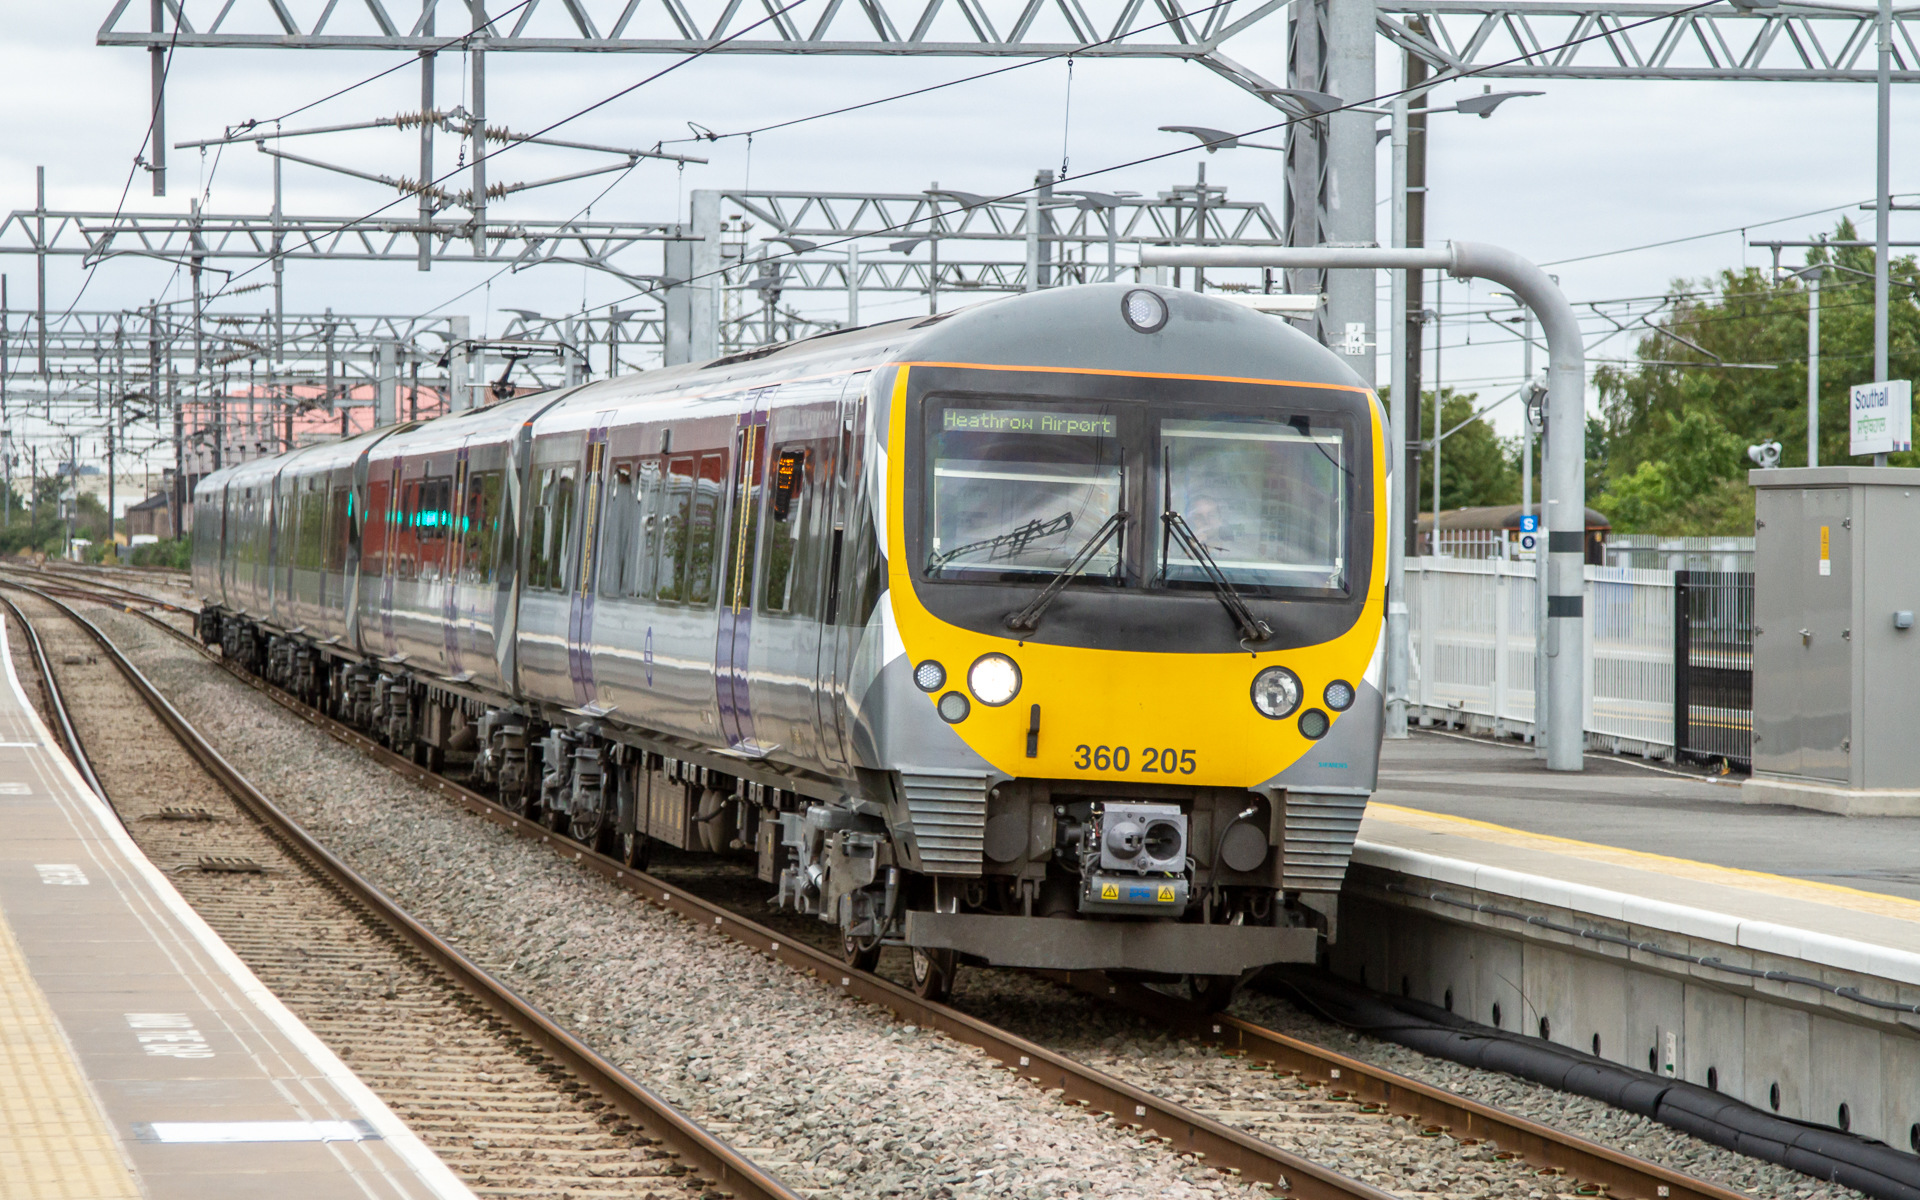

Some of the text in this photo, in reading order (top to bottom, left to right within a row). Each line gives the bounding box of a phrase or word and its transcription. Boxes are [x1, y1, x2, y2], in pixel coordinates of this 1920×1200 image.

[1855, 387, 1889, 410] Southall
[943, 411, 1111, 434] Heathrow Airport
[1523, 517, 1534, 531] S
[1074, 744, 1197, 775] 360 205
